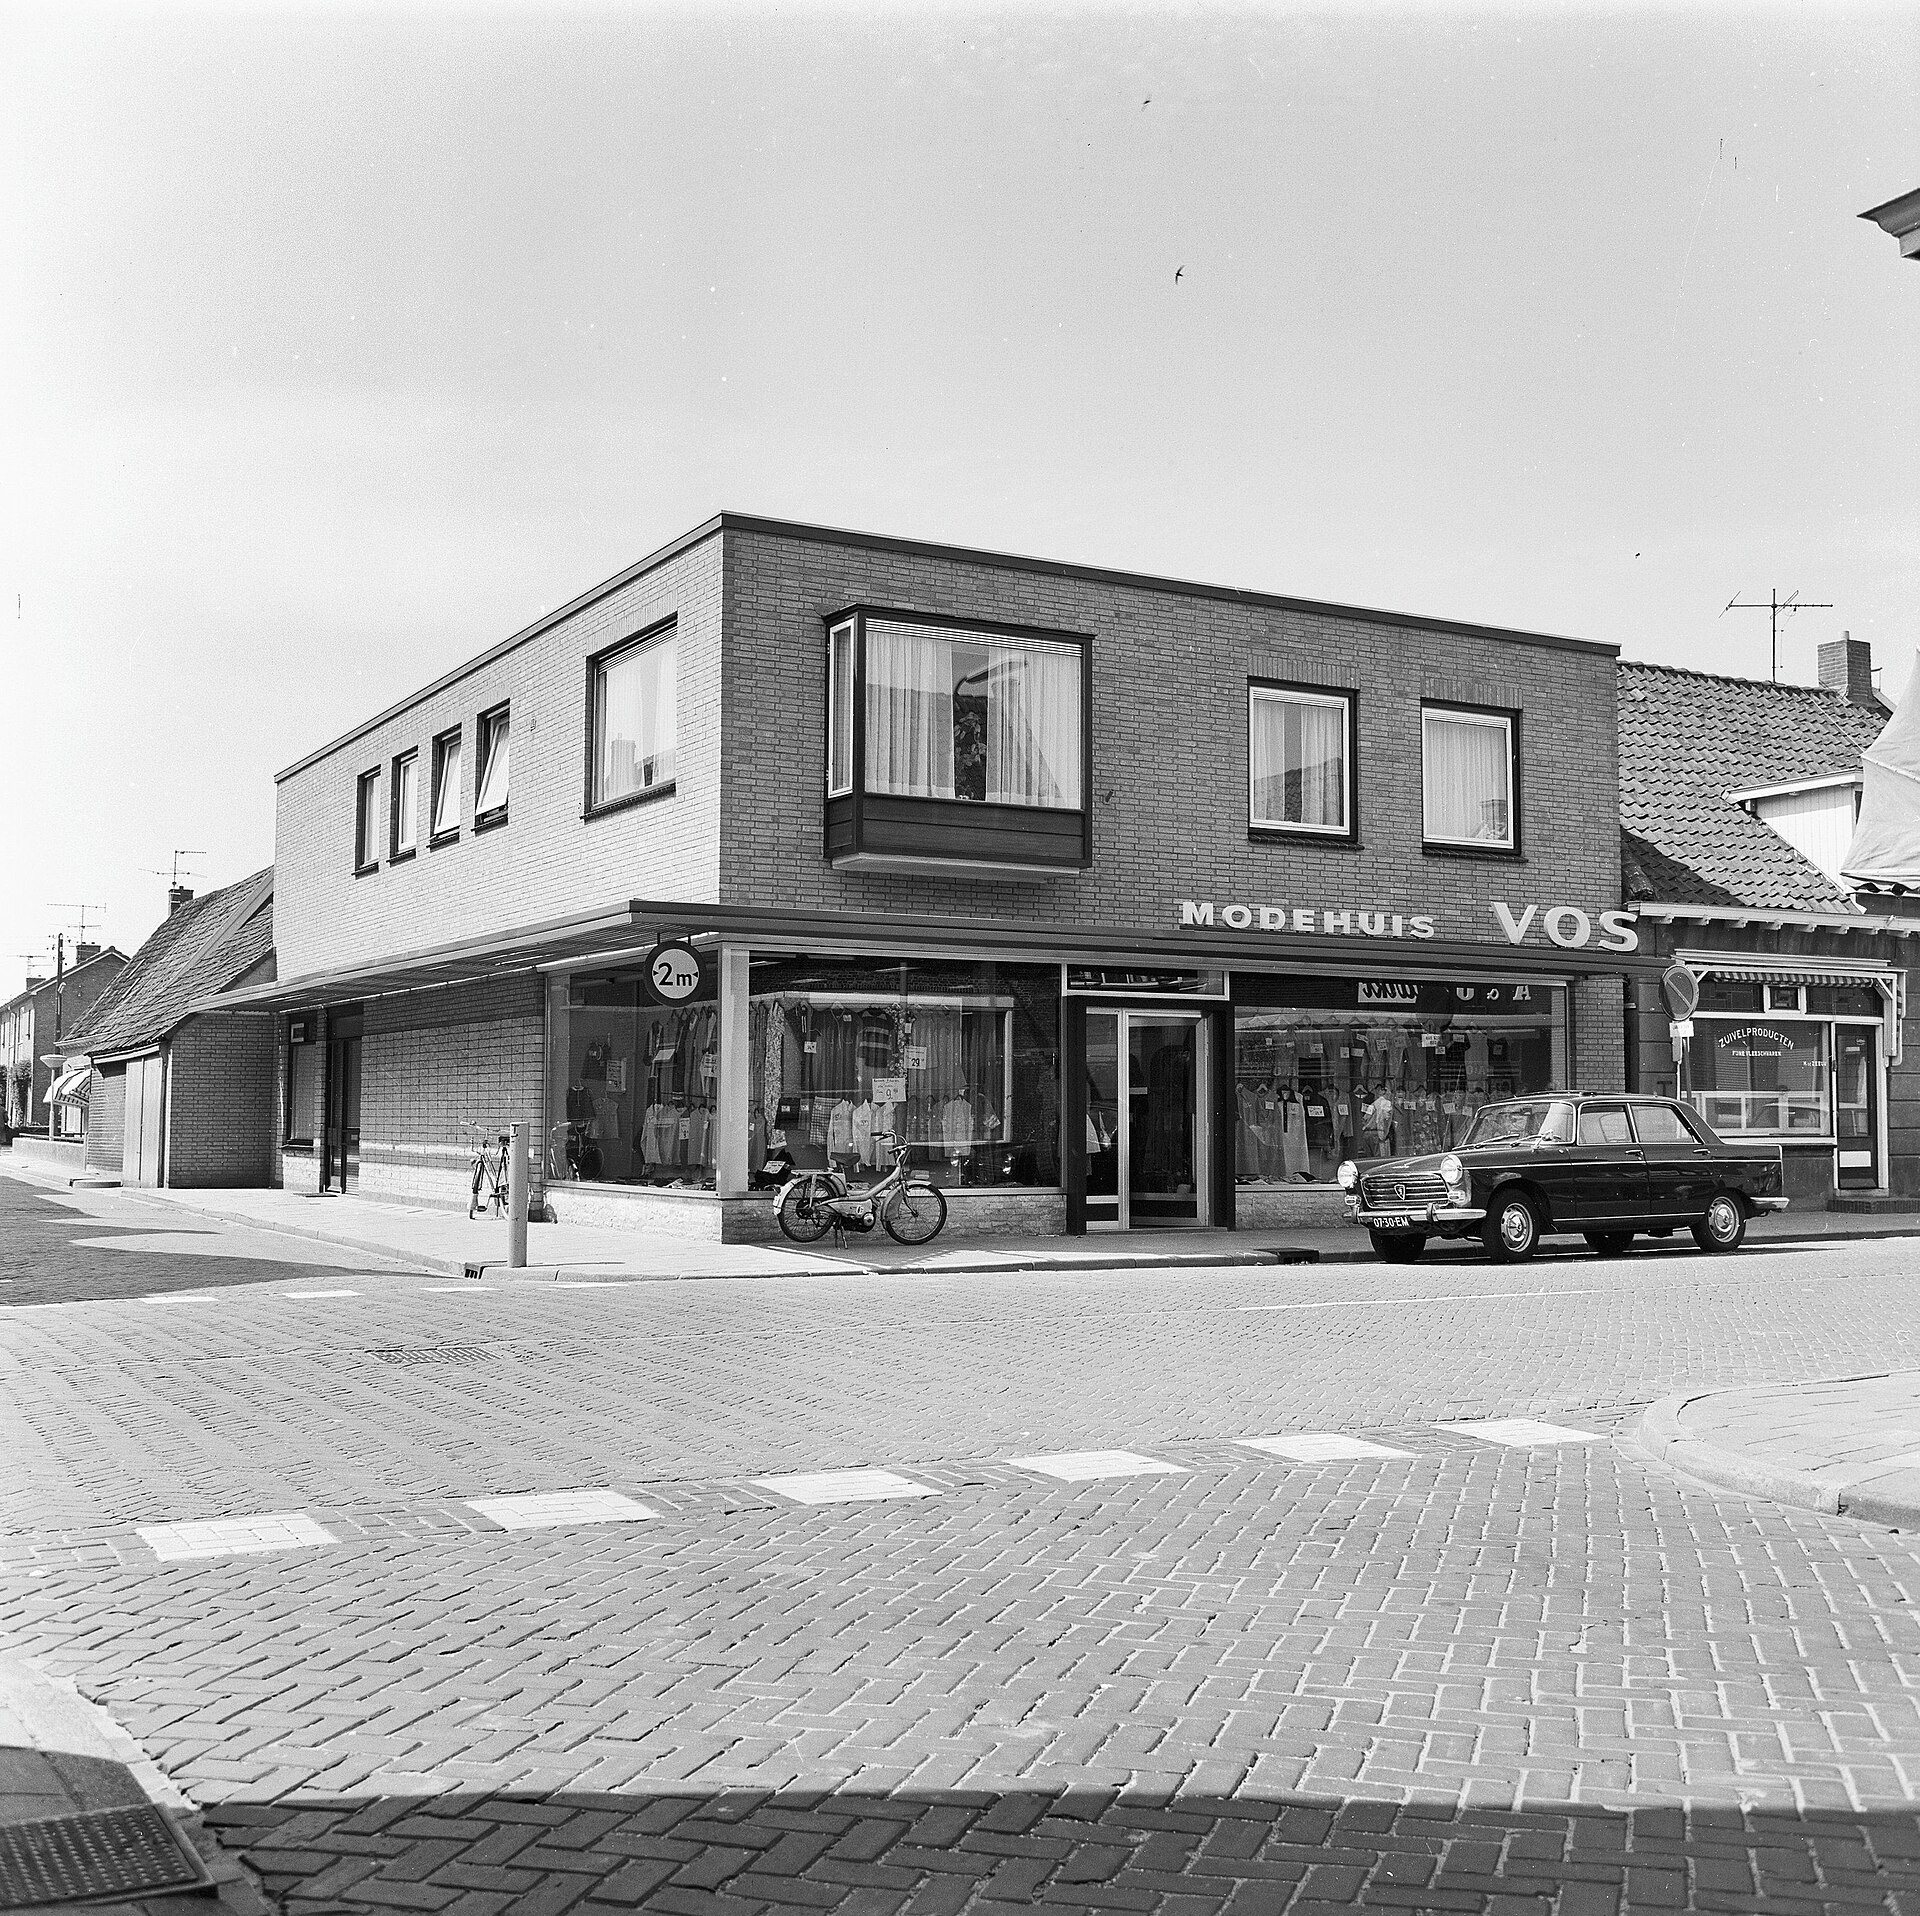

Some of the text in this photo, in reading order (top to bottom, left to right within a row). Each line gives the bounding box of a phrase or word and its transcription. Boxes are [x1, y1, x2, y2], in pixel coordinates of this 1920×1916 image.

[1182, 901, 1639, 952] MODEHUIS VOS
[1718, 1027, 1795, 1050] ZUIVELPRODUCTEN
[1373, 1216, 1409, 1227] 07-30-EM
